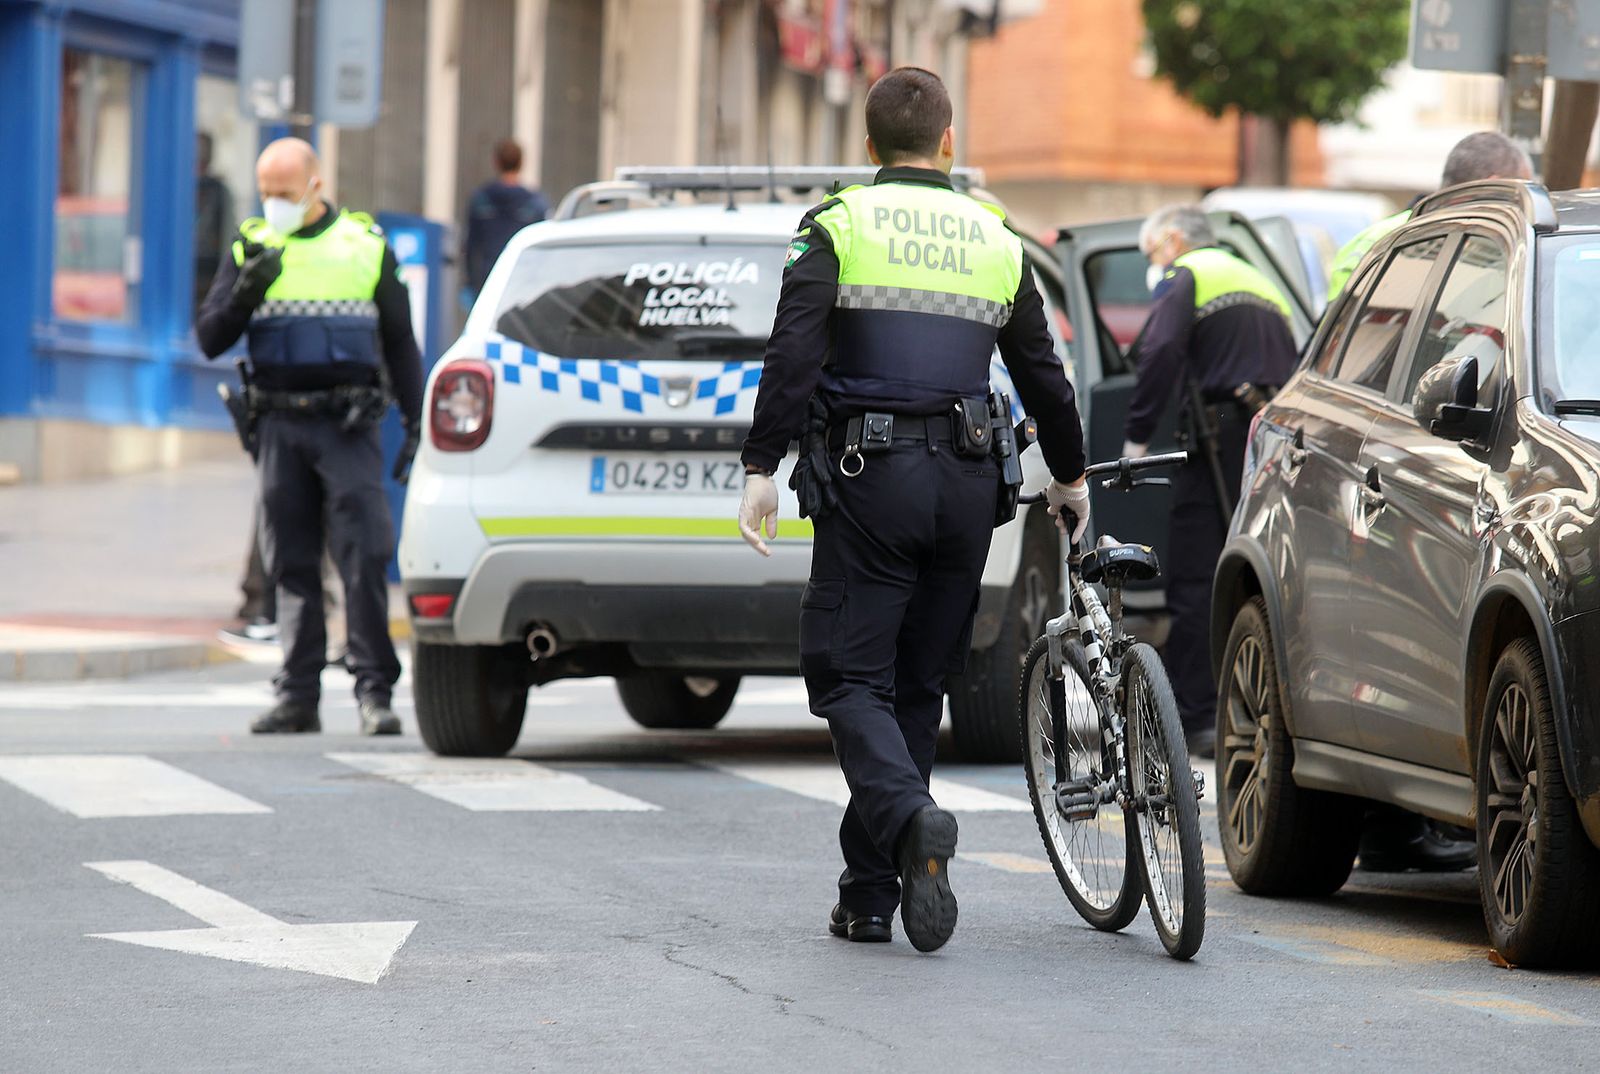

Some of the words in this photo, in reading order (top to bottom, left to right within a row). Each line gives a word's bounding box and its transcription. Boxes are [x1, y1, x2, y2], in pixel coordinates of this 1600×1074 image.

[874, 206, 986, 245] POLICIA
[888, 237, 973, 276] LOCAL
[623, 257, 759, 287] POLICÍA
[643, 286, 733, 308] LOCAL
[638, 306, 730, 327] HUELVA
[585, 427, 736, 443] DUSTE
[612, 460, 690, 490] 0429
[702, 461, 746, 490] KZ
